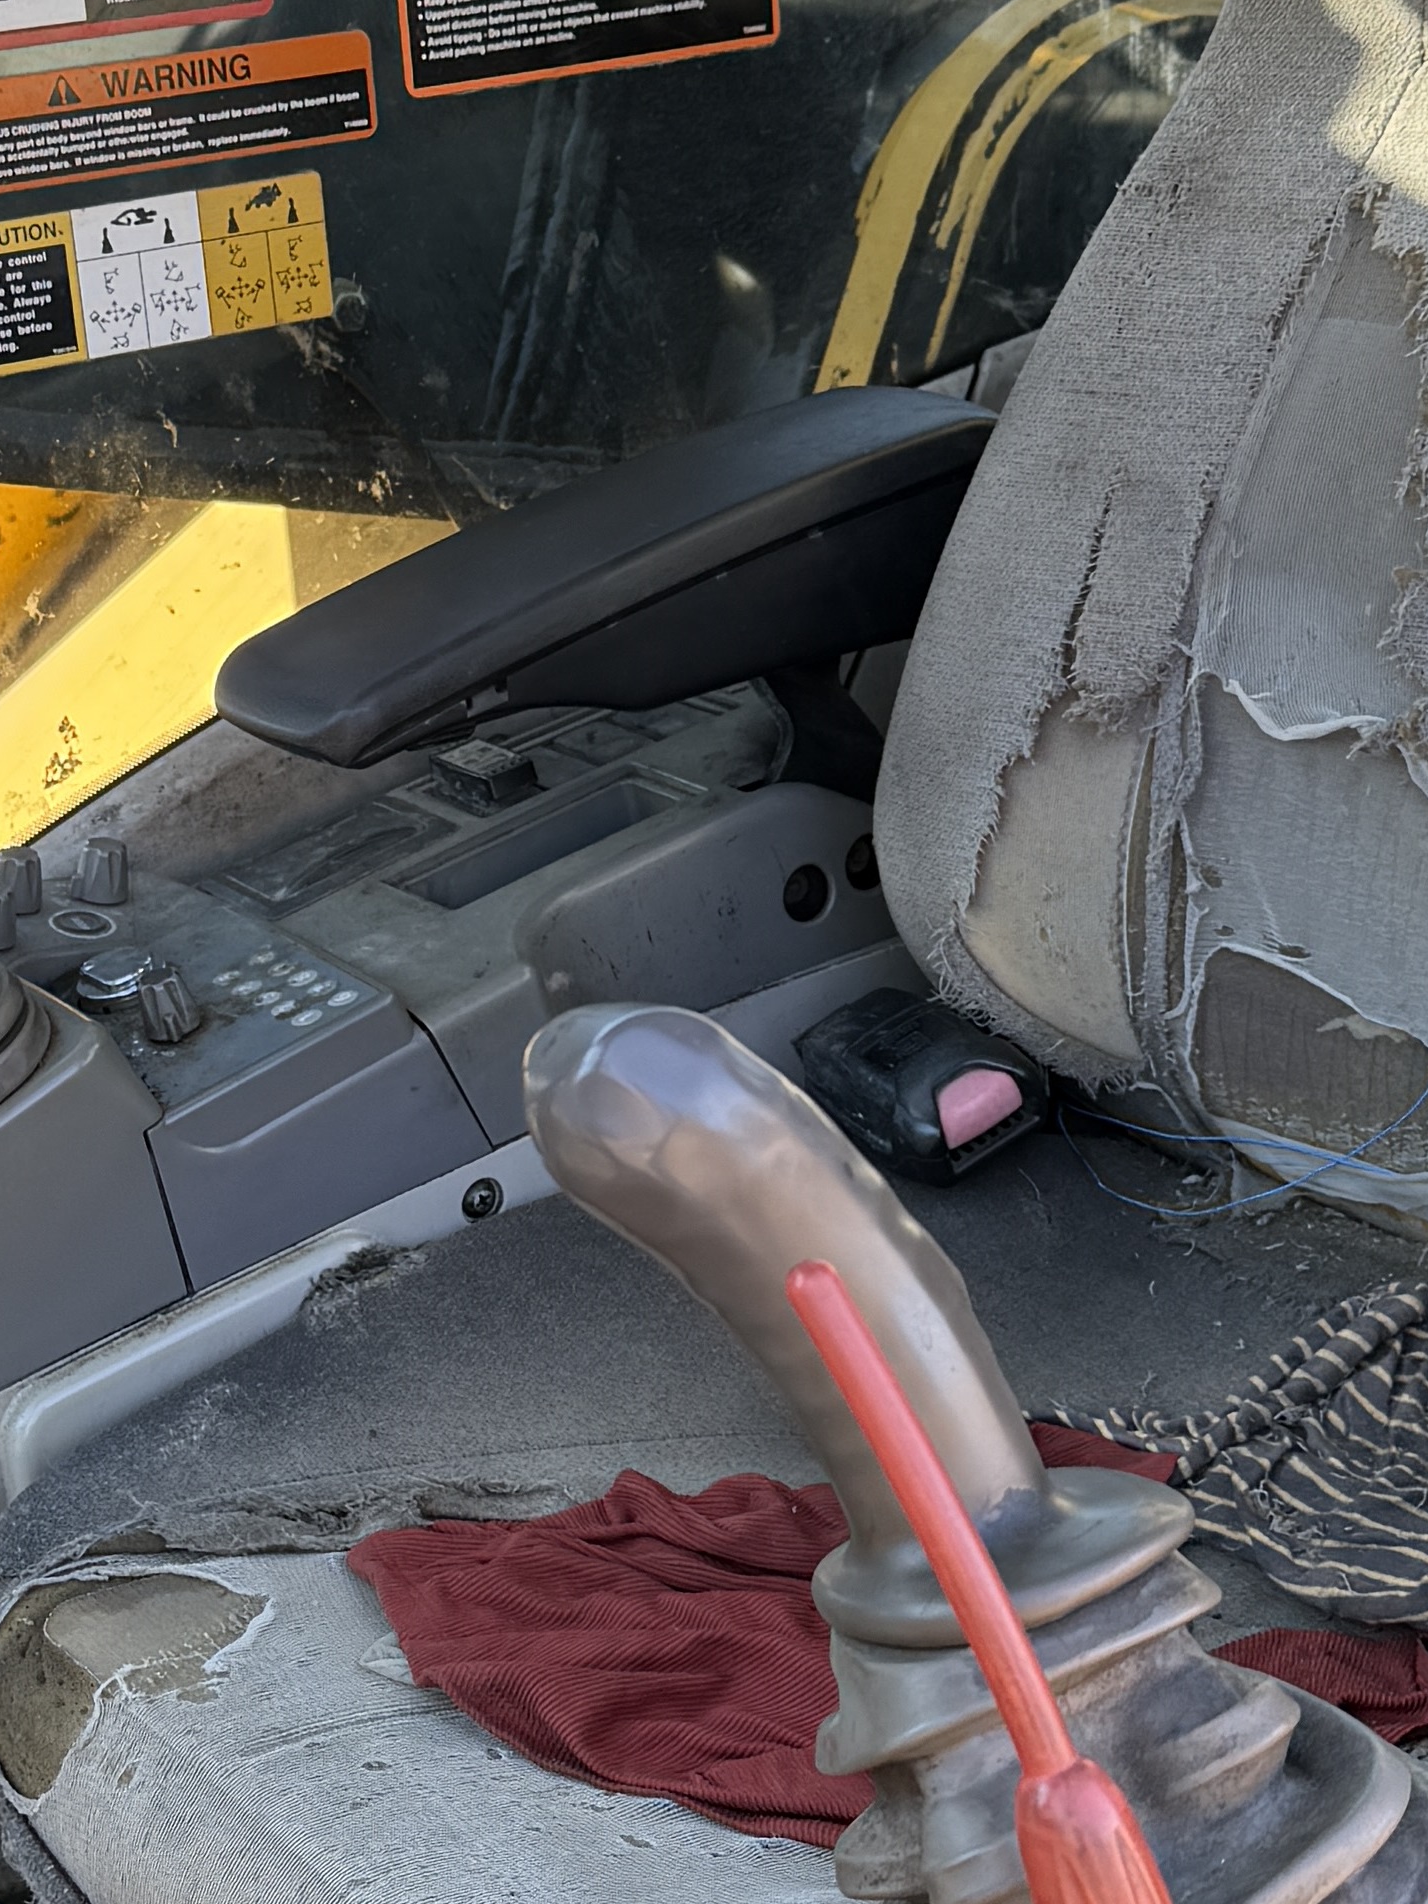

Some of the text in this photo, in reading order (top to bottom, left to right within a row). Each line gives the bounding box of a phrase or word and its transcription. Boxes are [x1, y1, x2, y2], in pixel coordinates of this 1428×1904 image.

[100, 52, 250, 99] WARNING
[11, 119, 59, 136] CRUSHING
[61, 114, 94, 129] INJURY
[95, 111, 122, 124] FROM
[123, 106, 152, 120] BOOM
[7, 251, 47, 267] control
[5, 270, 23, 281] are
[10, 282, 26, 294] for
[31, 278, 52, 291] this
[12, 291, 51, 310] Always
[17, 319, 53, 335] before
